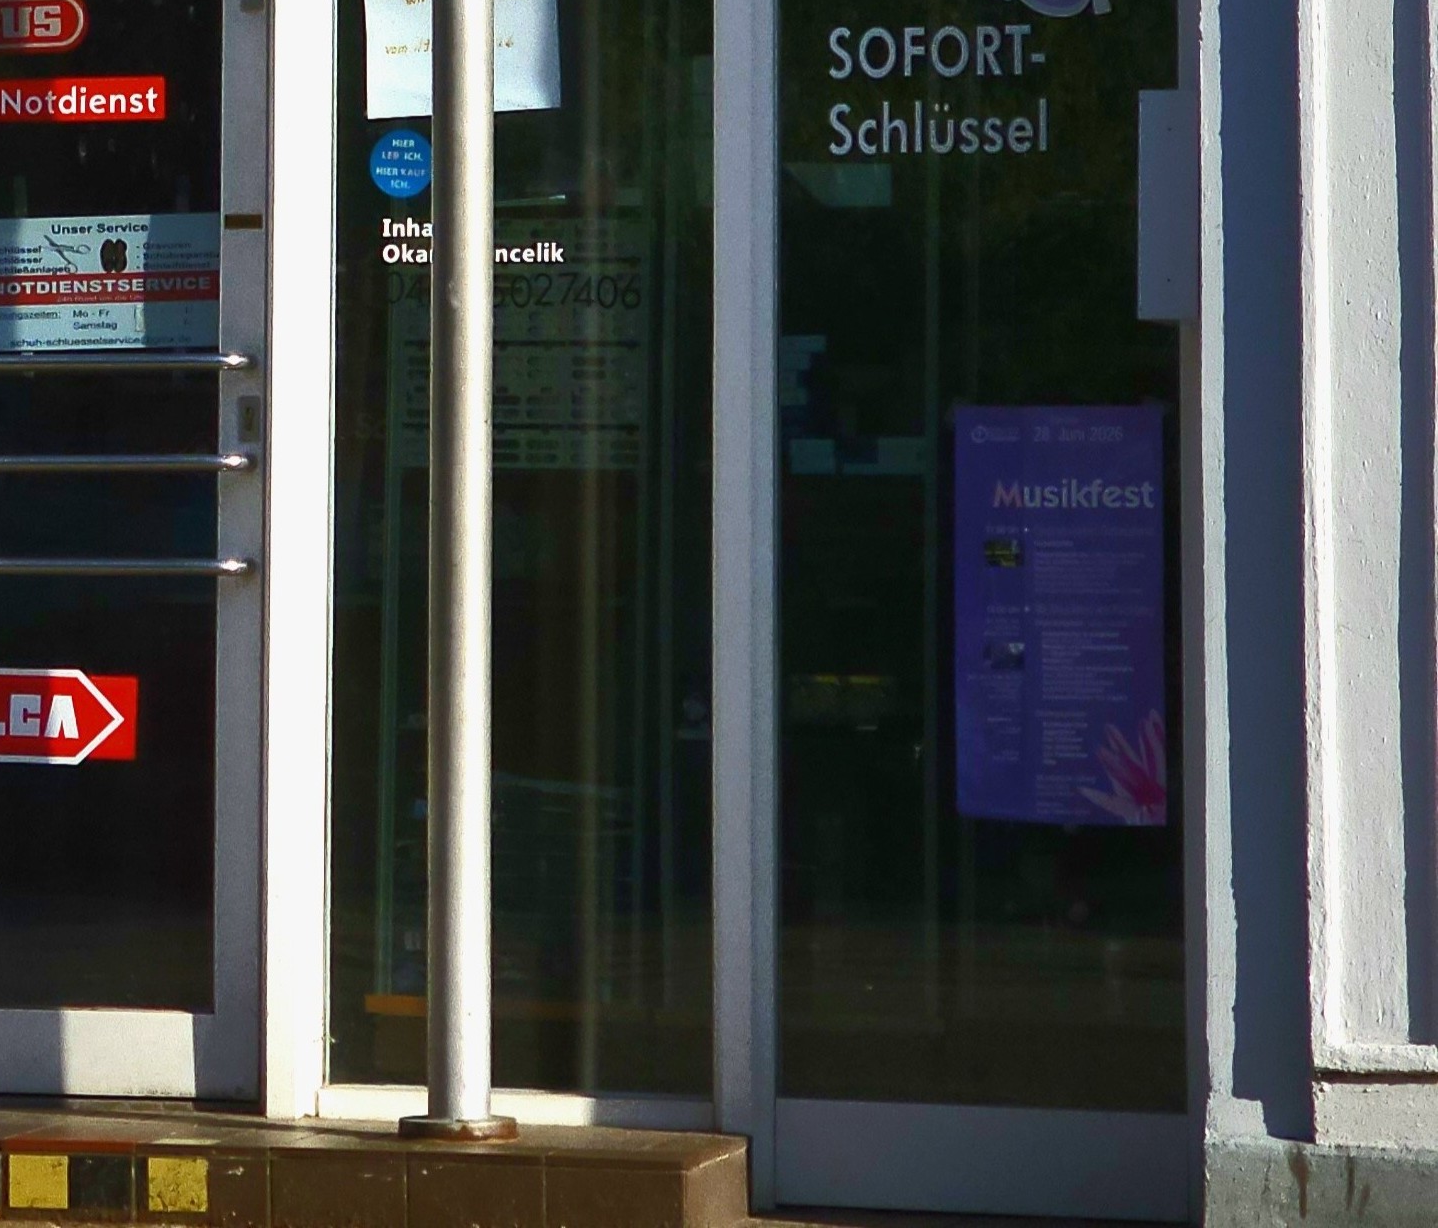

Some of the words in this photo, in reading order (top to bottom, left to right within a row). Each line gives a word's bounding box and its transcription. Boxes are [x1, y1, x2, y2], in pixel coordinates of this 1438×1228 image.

[828, 23, 1046, 80] SOFORT-
[828, 98, 1048, 156] Schlüssel
[392, 138, 415, 148] HIER
[51, 224, 93, 235] Unser
[96, 222, 149, 234] Service
[381, 218, 433, 238] Inha
[381, 243, 433, 264] Oka
[992, 478, 1155, 509] Musikfest
